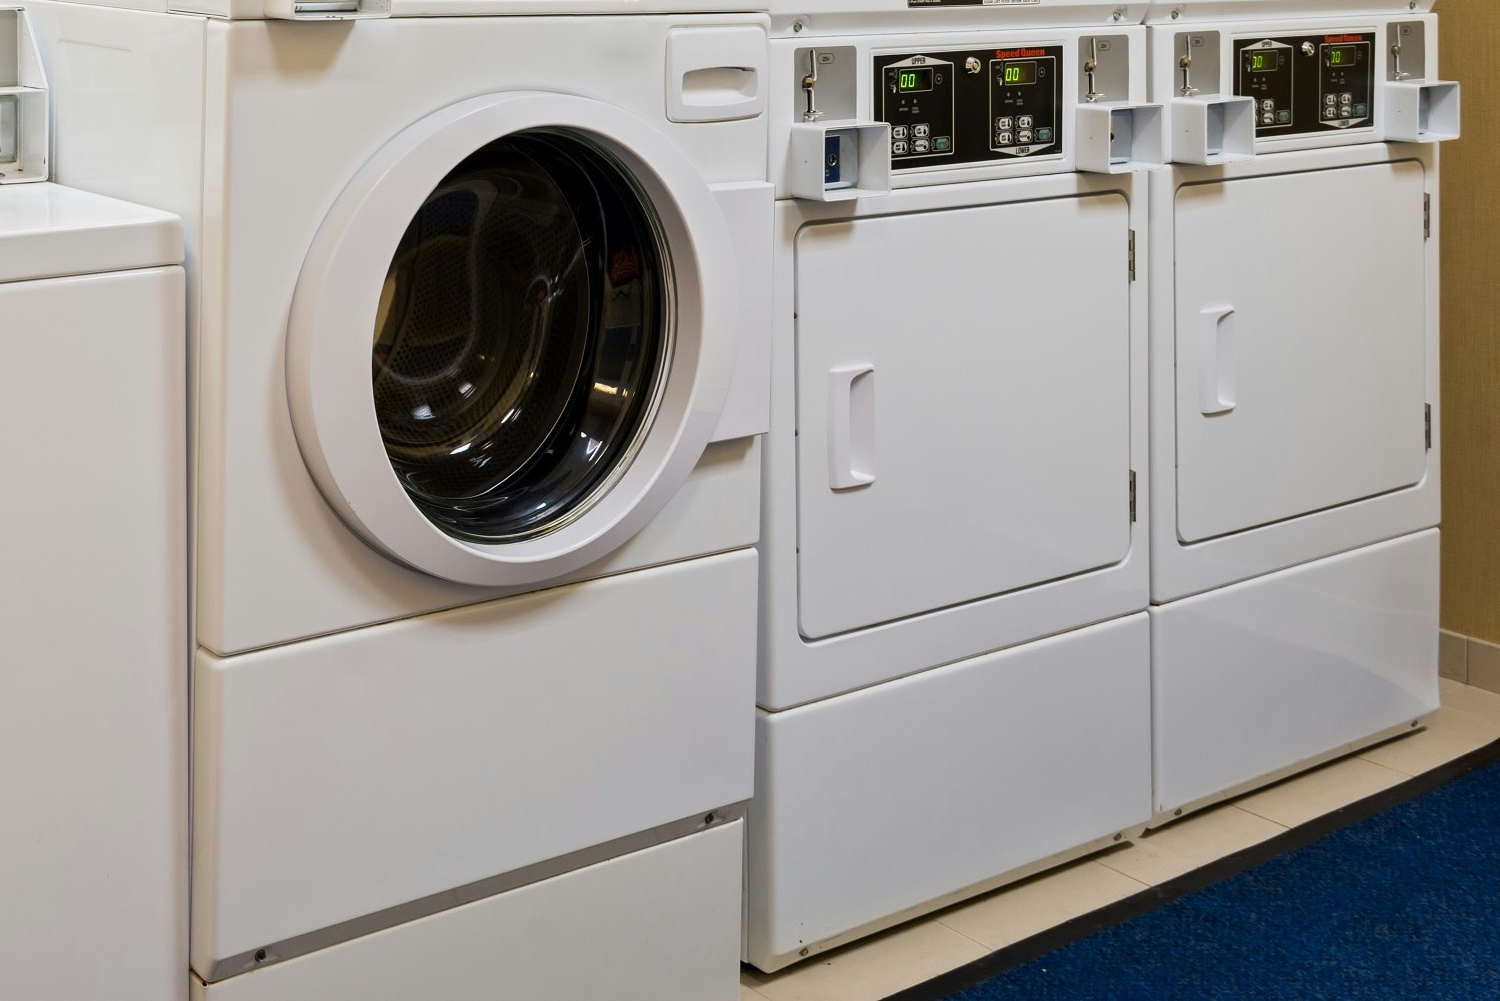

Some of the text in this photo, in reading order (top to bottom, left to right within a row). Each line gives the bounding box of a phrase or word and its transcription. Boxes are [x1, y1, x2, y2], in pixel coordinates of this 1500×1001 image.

[911, 57, 926, 65] UPPER
[996, 48, 1045, 61] Speed Queen
[900, 73, 916, 88] 00
[1005, 68, 1020, 82] 00
[1015, 146, 1030, 155] LOWER
